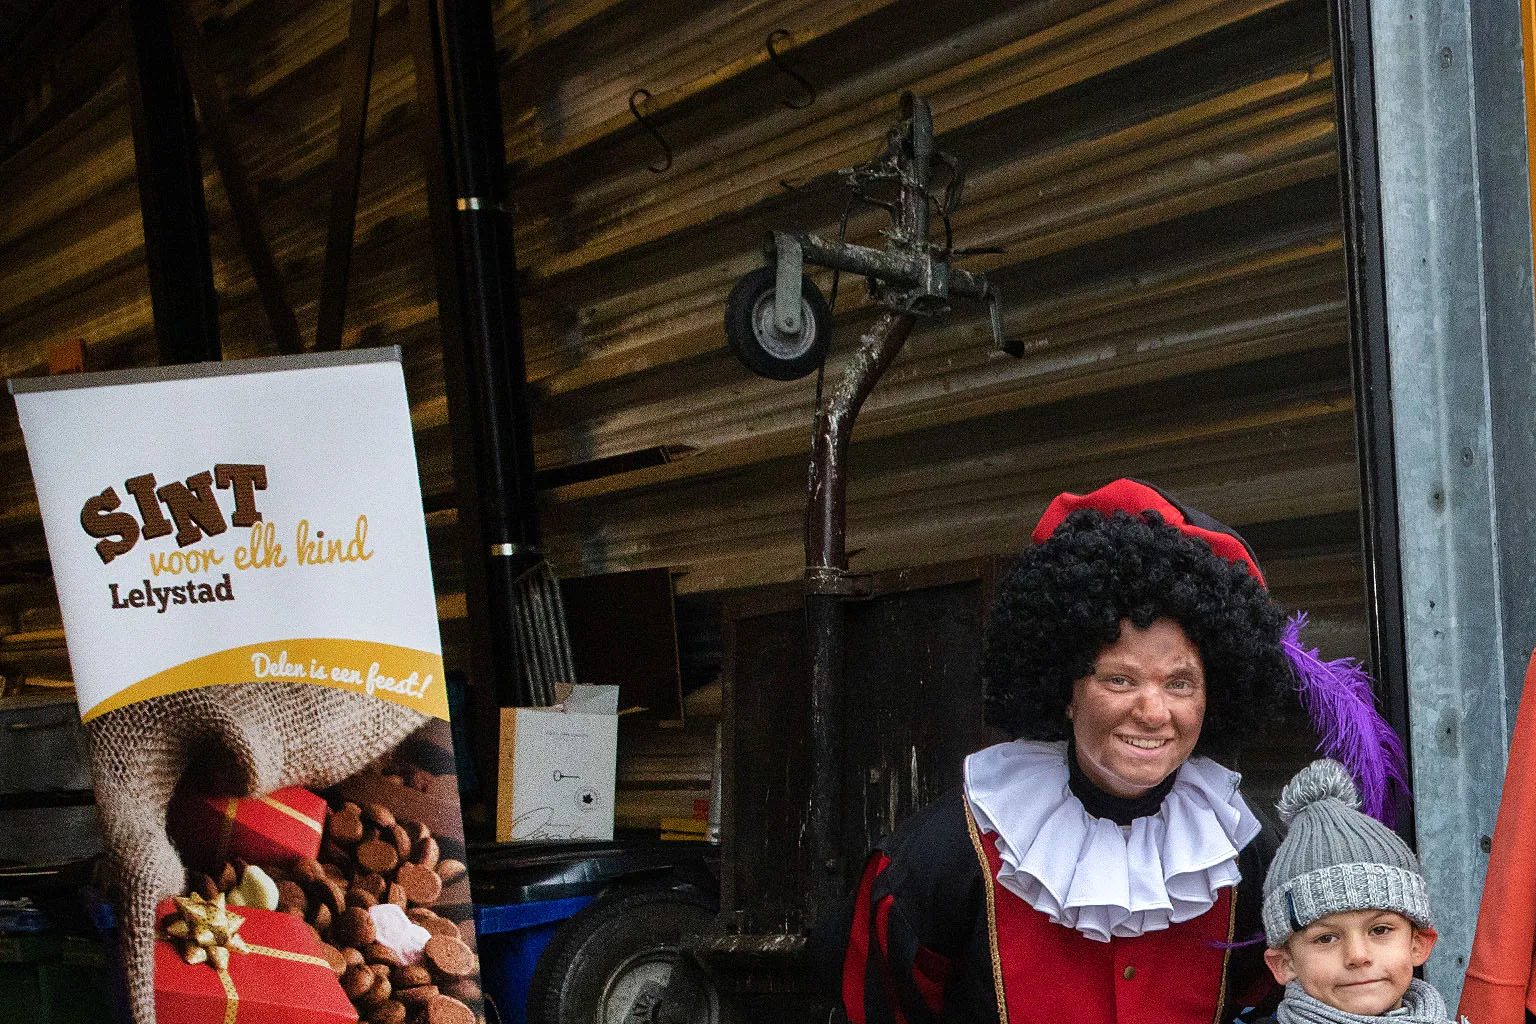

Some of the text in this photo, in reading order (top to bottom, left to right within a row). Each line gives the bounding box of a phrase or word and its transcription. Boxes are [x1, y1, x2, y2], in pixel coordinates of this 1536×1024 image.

[80, 463, 268, 565] SINT
[150, 514, 374, 576] voor elk kind
[108, 573, 236, 614] Lelystad
[251, 650, 433, 699] Delen is een feest!
